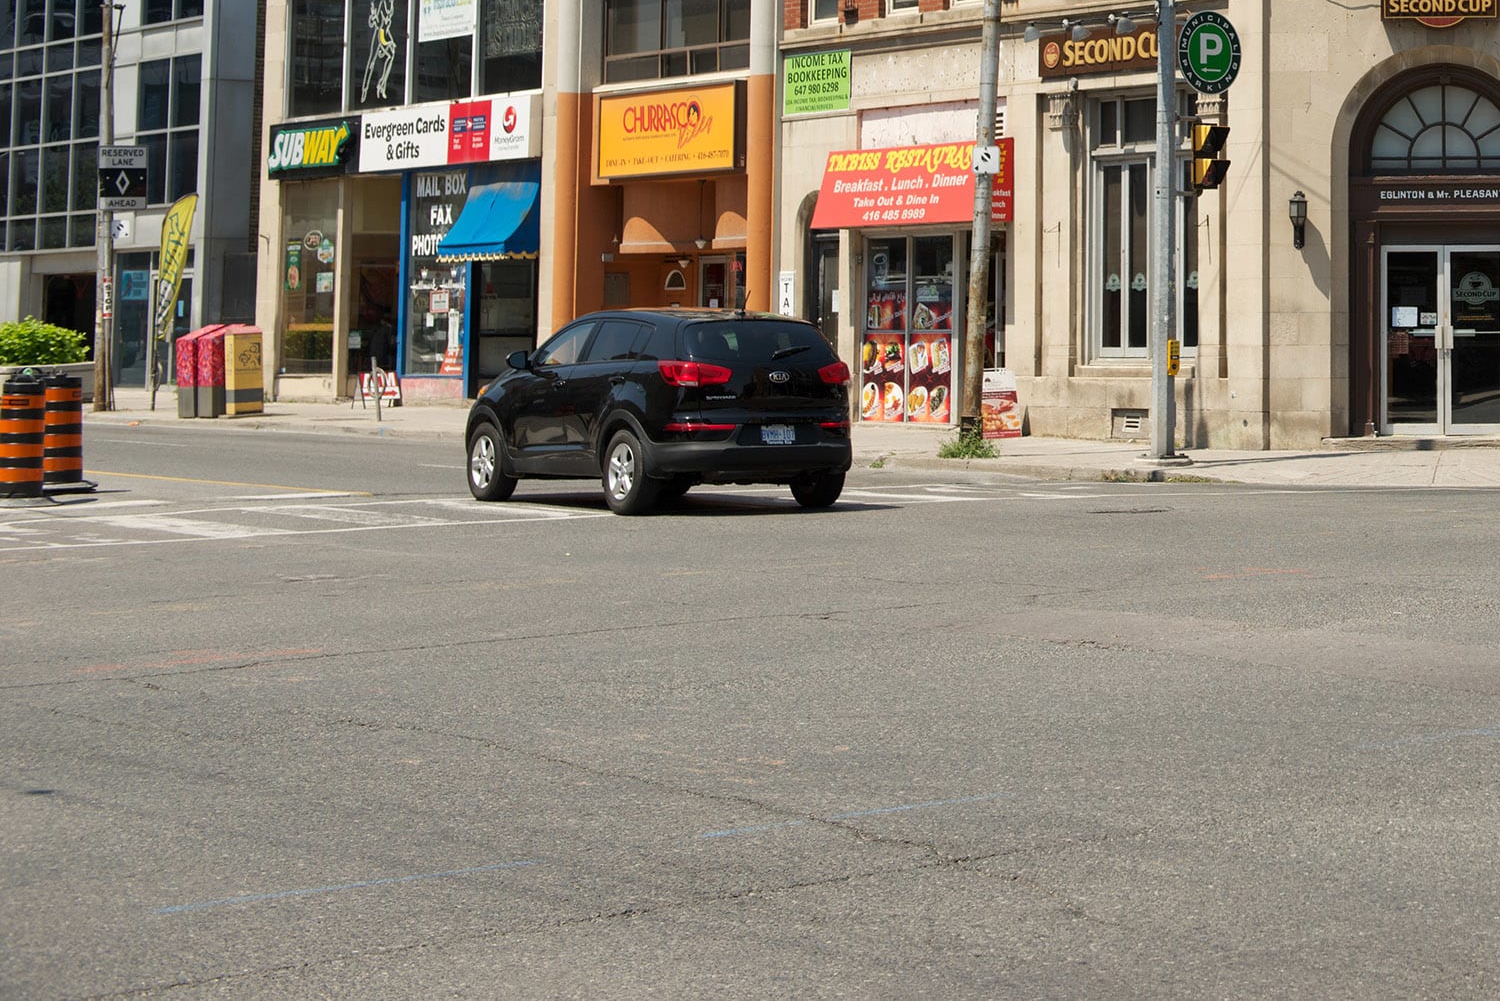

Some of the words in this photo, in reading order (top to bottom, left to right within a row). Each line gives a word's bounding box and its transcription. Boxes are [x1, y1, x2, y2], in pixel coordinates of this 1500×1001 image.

[1182, 15, 1238, 50] MUNICIPAL
[1062, 36, 1137, 67] SECOND
[1136, 31, 1159, 59] CU
[791, 55, 825, 69] INCOME
[828, 53, 843, 65] TAX
[787, 67, 847, 84] BOOKKEEPING
[1182, 59, 1238, 91] PARKING
[794, 85, 807, 95] 647
[822, 82, 839, 93] 6298
[623, 100, 701, 134] CHURRASCO
[365, 118, 413, 144] Evergreen
[415, 114, 445, 135] Cards
[102, 149, 144, 157] RESERVED
[269, 121, 349, 171] SUBWAY
[386, 146, 394, 160] &
[395, 143, 420, 159] Gifts
[112, 158, 134, 166] LANE
[417, 176, 440, 197] MAIL
[445, 173, 467, 195] BOX
[833, 178, 883, 193] Breakfast
[891, 175, 923, 190] Lunch
[932, 173, 969, 188] Dinner
[108, 199, 136, 207] AHEAD
[853, 196, 875, 208] Take
[877, 195, 894, 207] Out
[896, 196, 903, 205] &
[906, 194, 928, 205] Dine
[930, 193, 939, 203] In
[1380, 190, 1425, 199] EGLINTON
[1428, 191, 1434, 199] &
[430, 203, 453, 226] FAX
[862, 210, 880, 221] 416
[882, 209, 900, 220] 485
[902, 207, 925, 219] 8989
[773, 372, 786, 381] KIA
